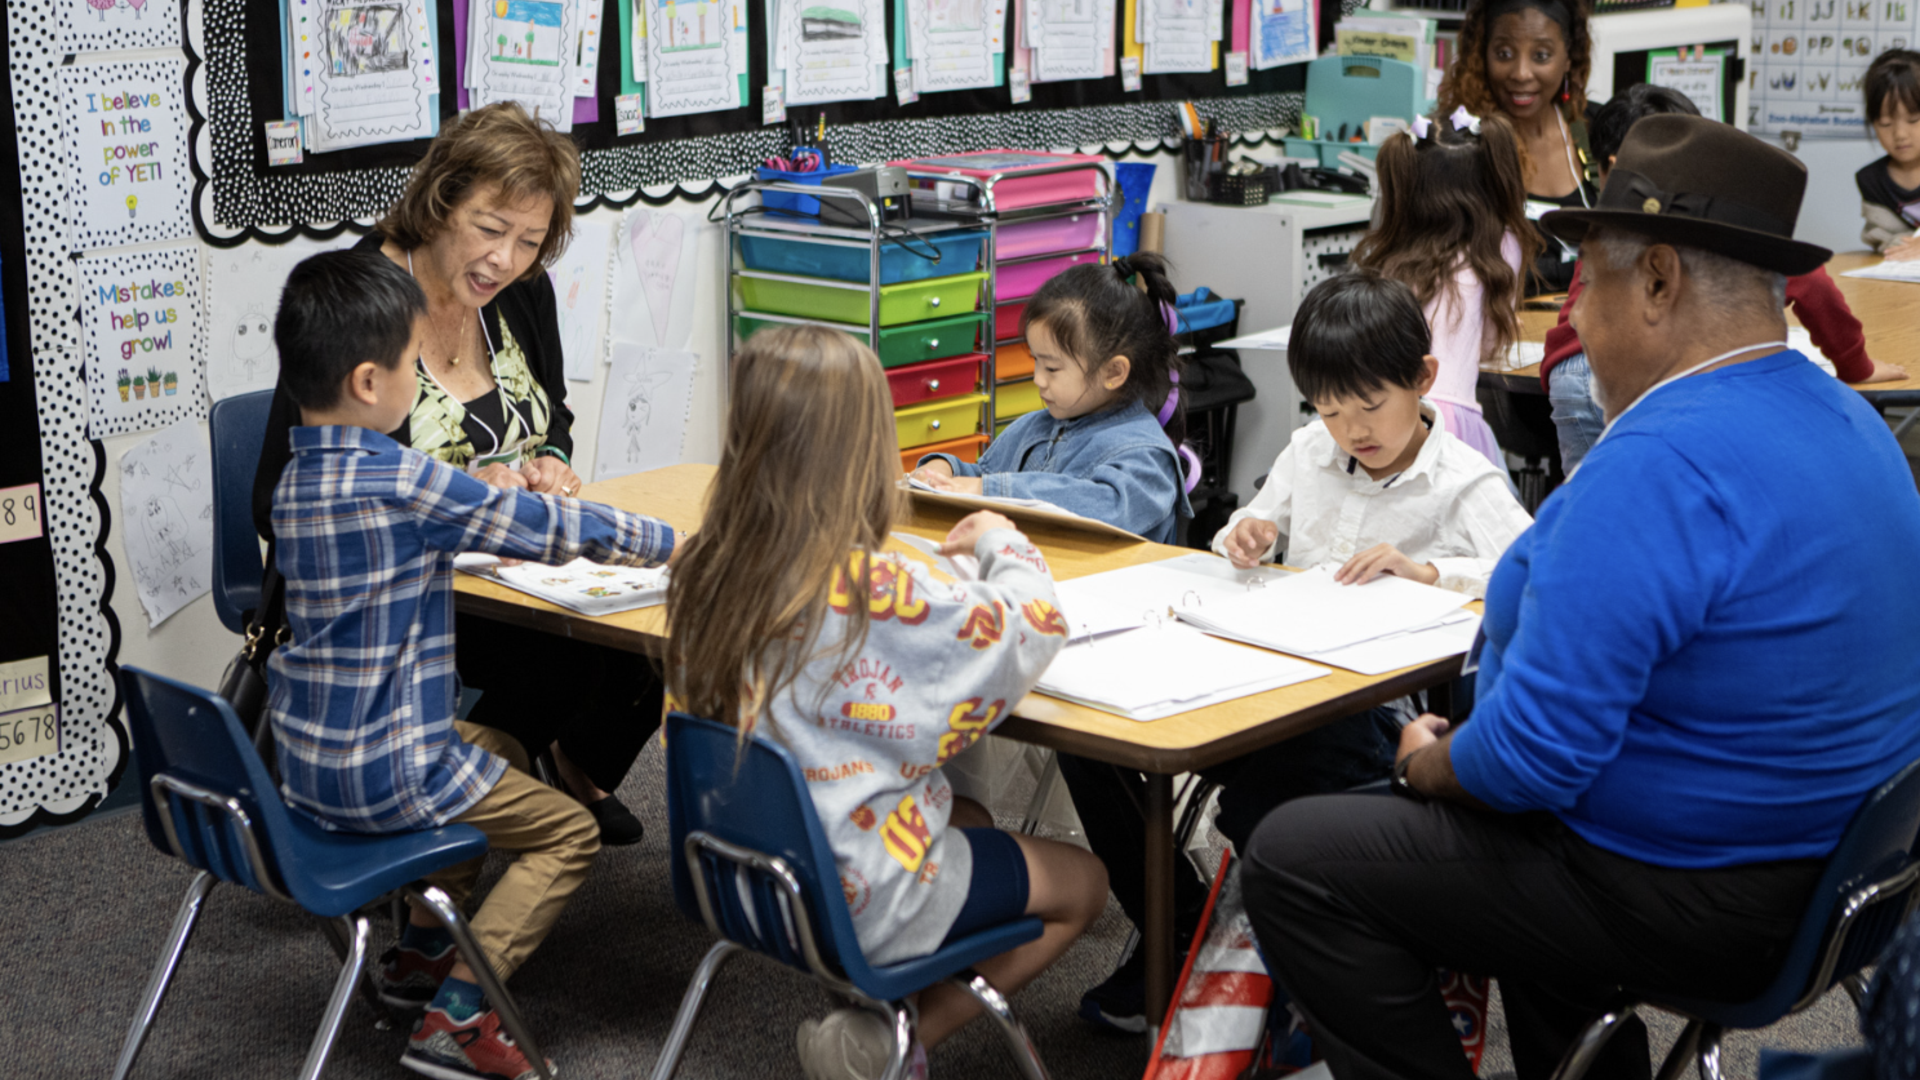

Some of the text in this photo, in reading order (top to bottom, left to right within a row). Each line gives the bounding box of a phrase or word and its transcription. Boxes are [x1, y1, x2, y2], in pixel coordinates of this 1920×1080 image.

[86, 90, 161, 113] I believe
[119, 115, 151, 135] the
[103, 141, 159, 166] power
[99, 166, 120, 186] of
[98, 279, 185, 306] Mistakes
[110, 307, 178, 332] help us
[0, 672, 45, 696] rius
[849, 702, 891, 722] 1880
